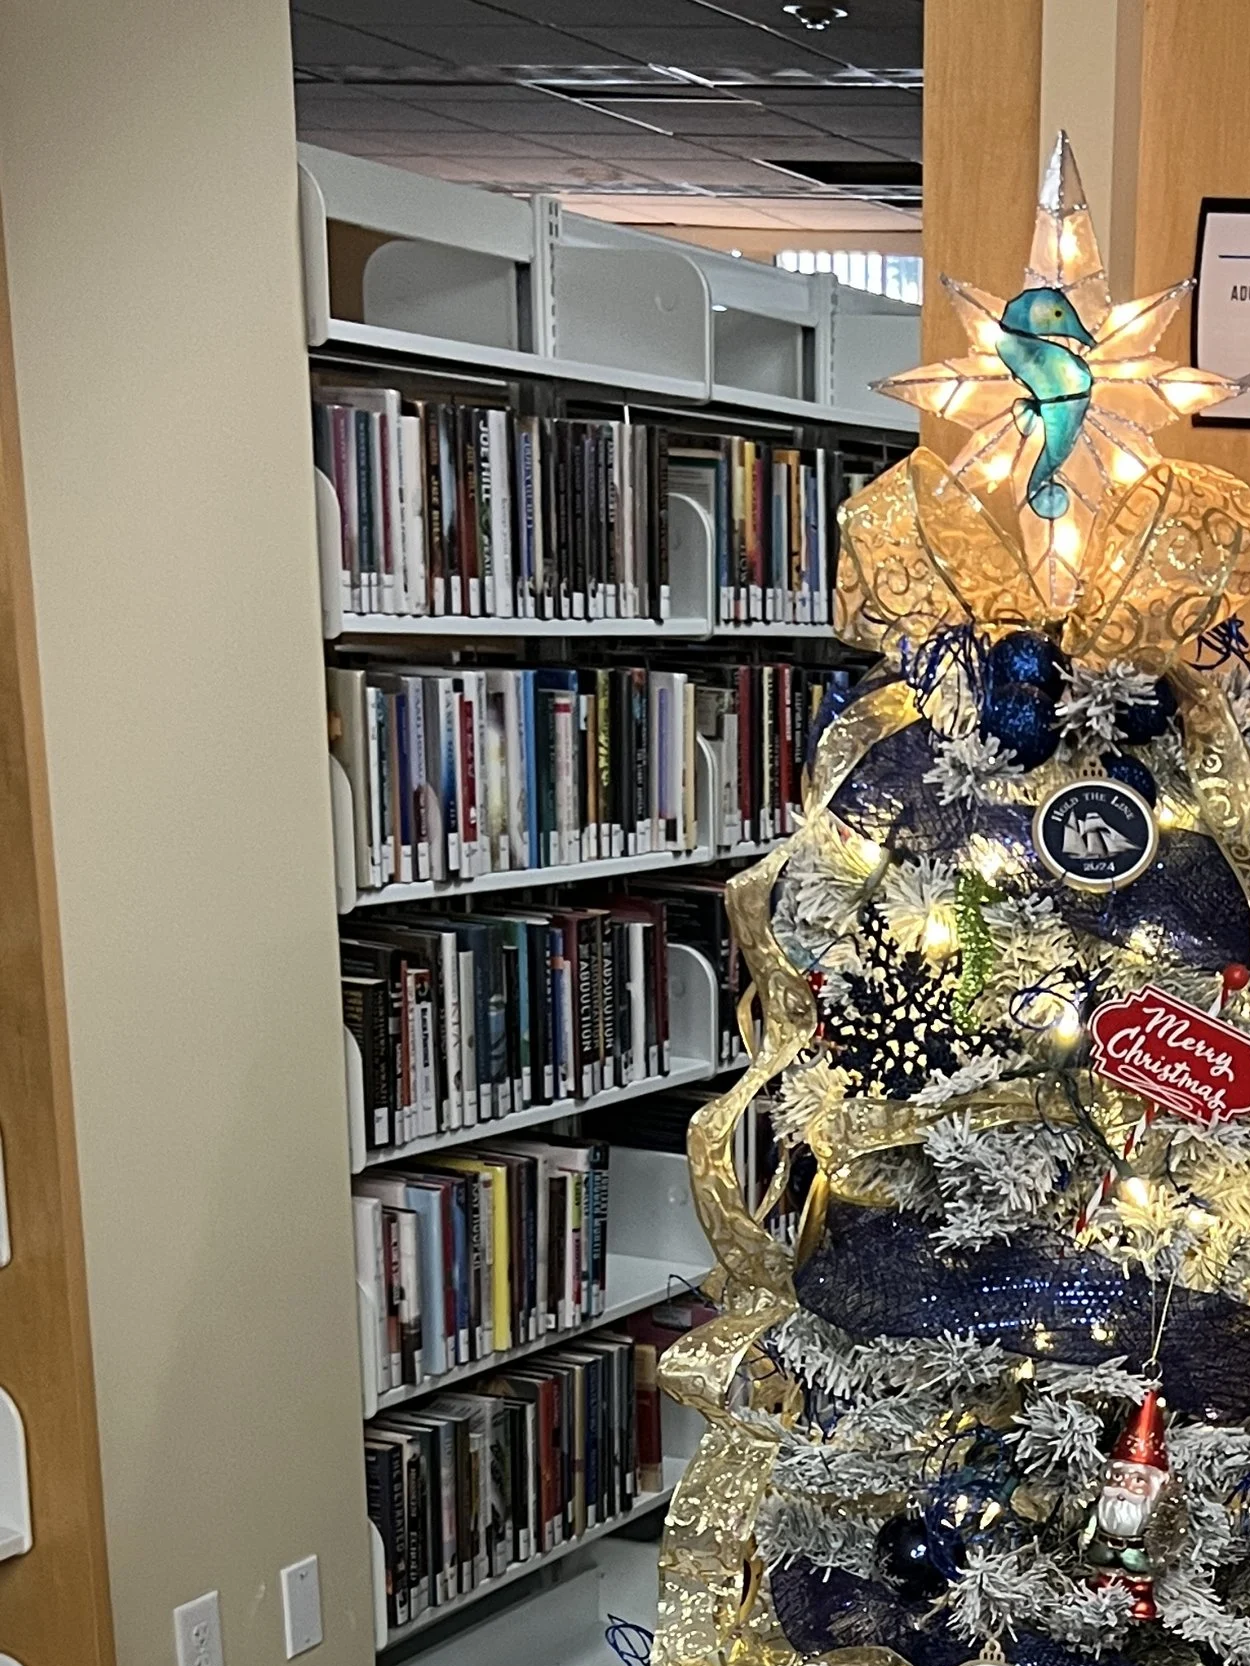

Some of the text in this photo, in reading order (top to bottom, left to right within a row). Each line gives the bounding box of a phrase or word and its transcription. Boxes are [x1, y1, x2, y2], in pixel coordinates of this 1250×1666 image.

[478, 420, 492, 503] JOE HILL
[1051, 792, 1135, 822] HOLD THE LINE
[1107, 1026, 1227, 1109] Christmas
[1143, 1007, 1234, 1082] Merry
